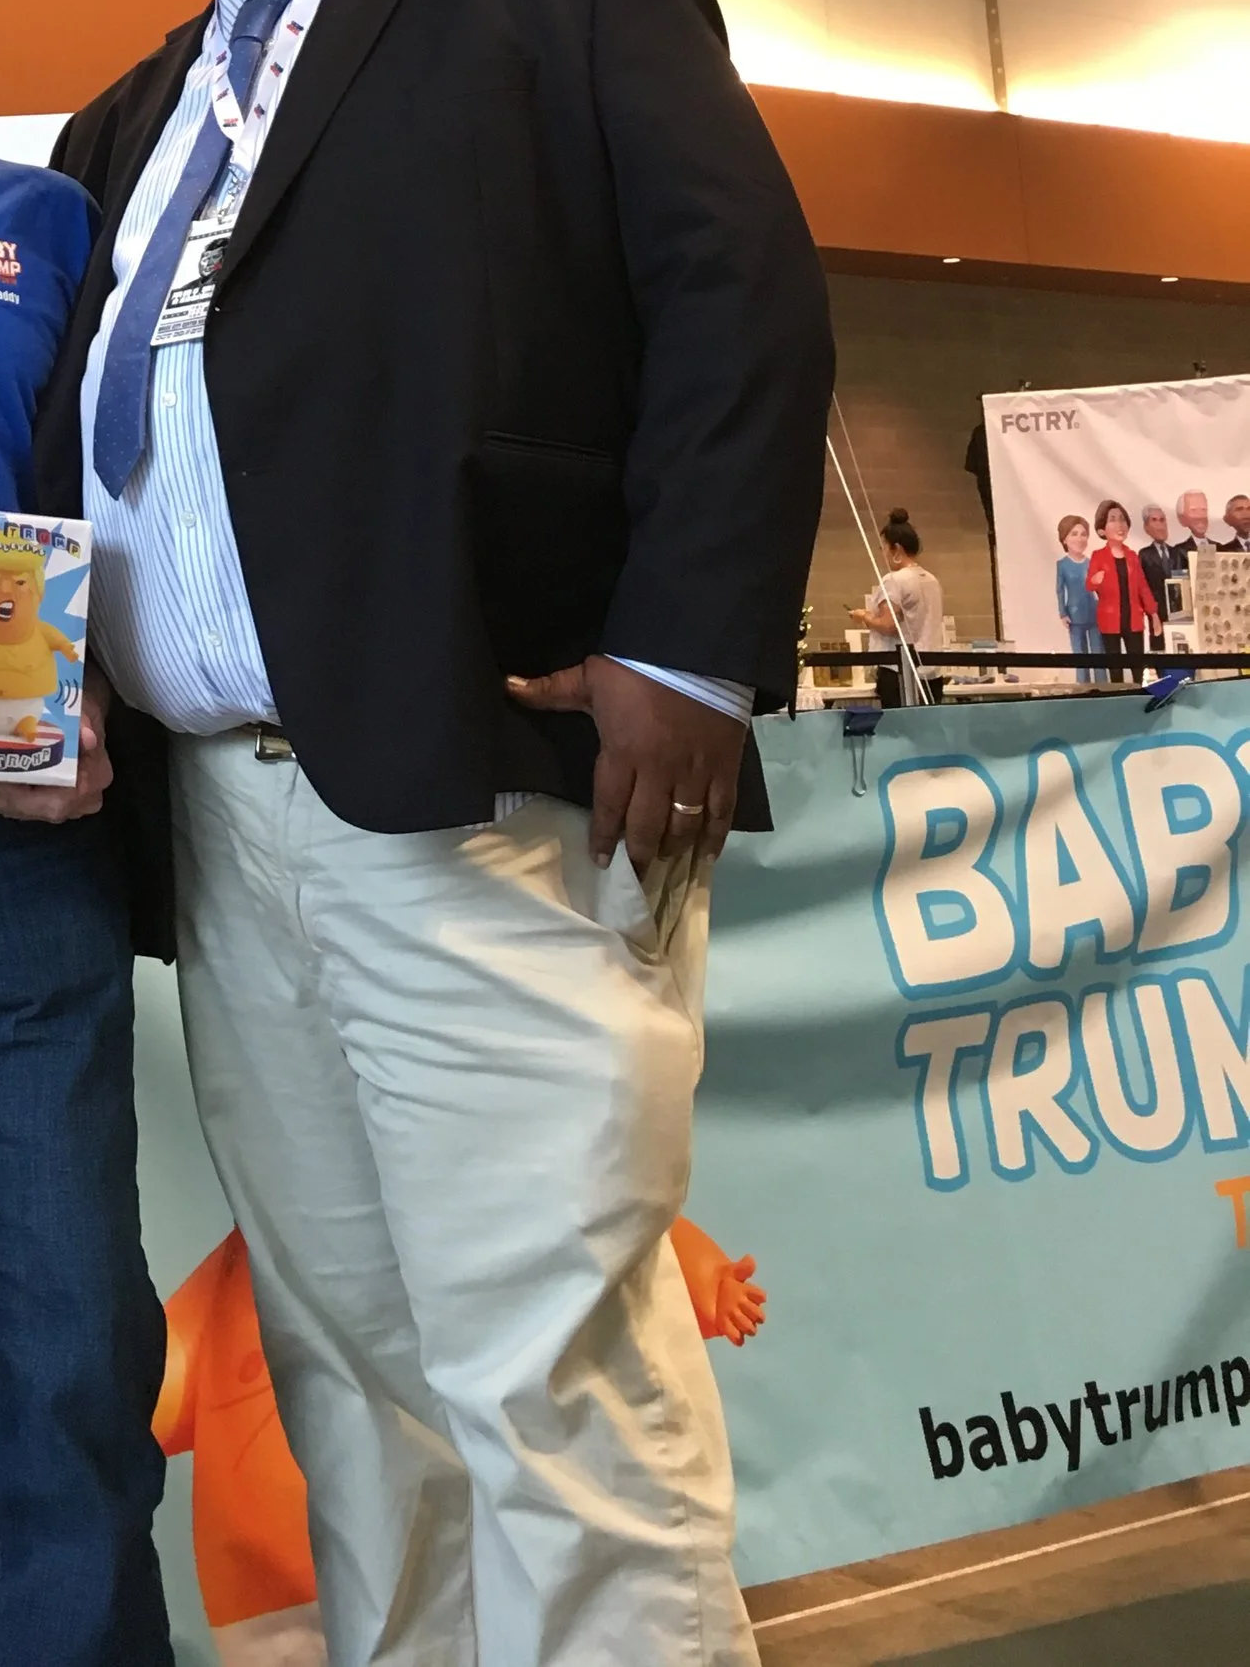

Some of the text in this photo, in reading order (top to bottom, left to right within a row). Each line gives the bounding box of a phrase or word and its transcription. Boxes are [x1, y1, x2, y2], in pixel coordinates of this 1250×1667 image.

[1001, 409, 1077, 434] FCTRY
[4, 522, 81, 559] TRUMP
[873, 727, 1250, 1002] BAB
